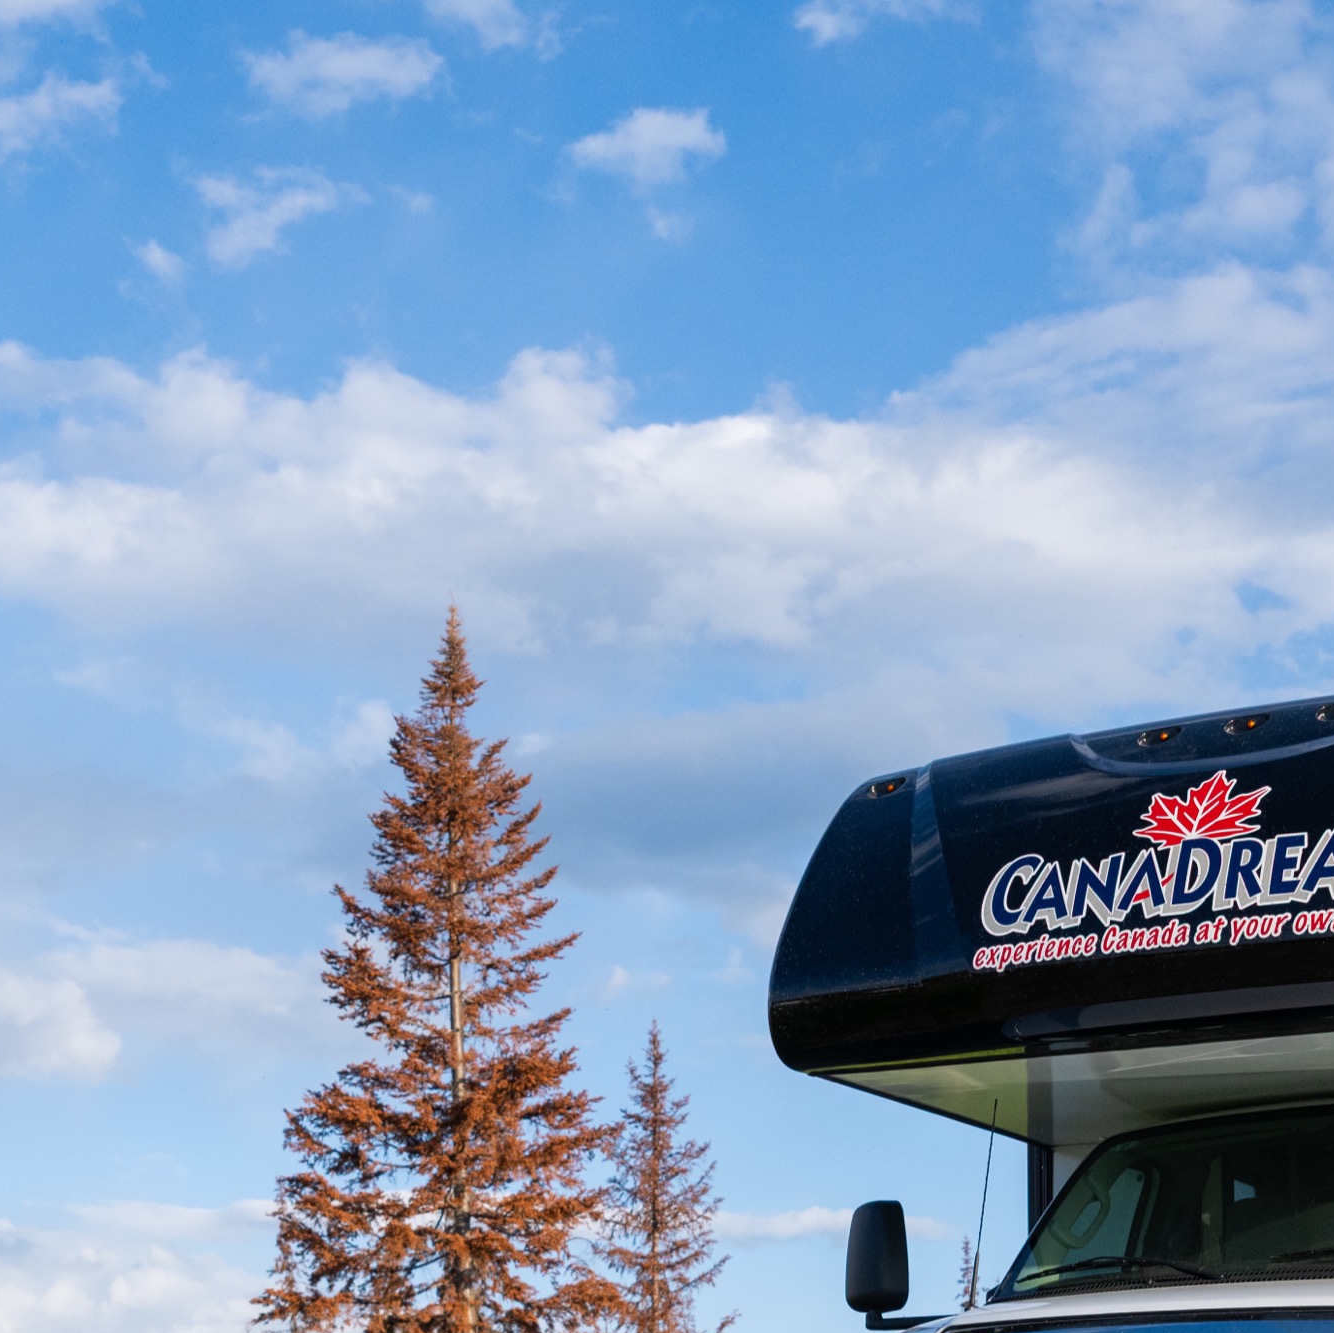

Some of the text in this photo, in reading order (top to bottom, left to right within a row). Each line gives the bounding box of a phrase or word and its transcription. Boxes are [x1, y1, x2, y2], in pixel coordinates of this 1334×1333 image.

[973, 934, 1098, 972] experience
[1101, 918, 1190, 951] Canada
[1194, 915, 1227, 943] at
[1230, 911, 1292, 945] your
